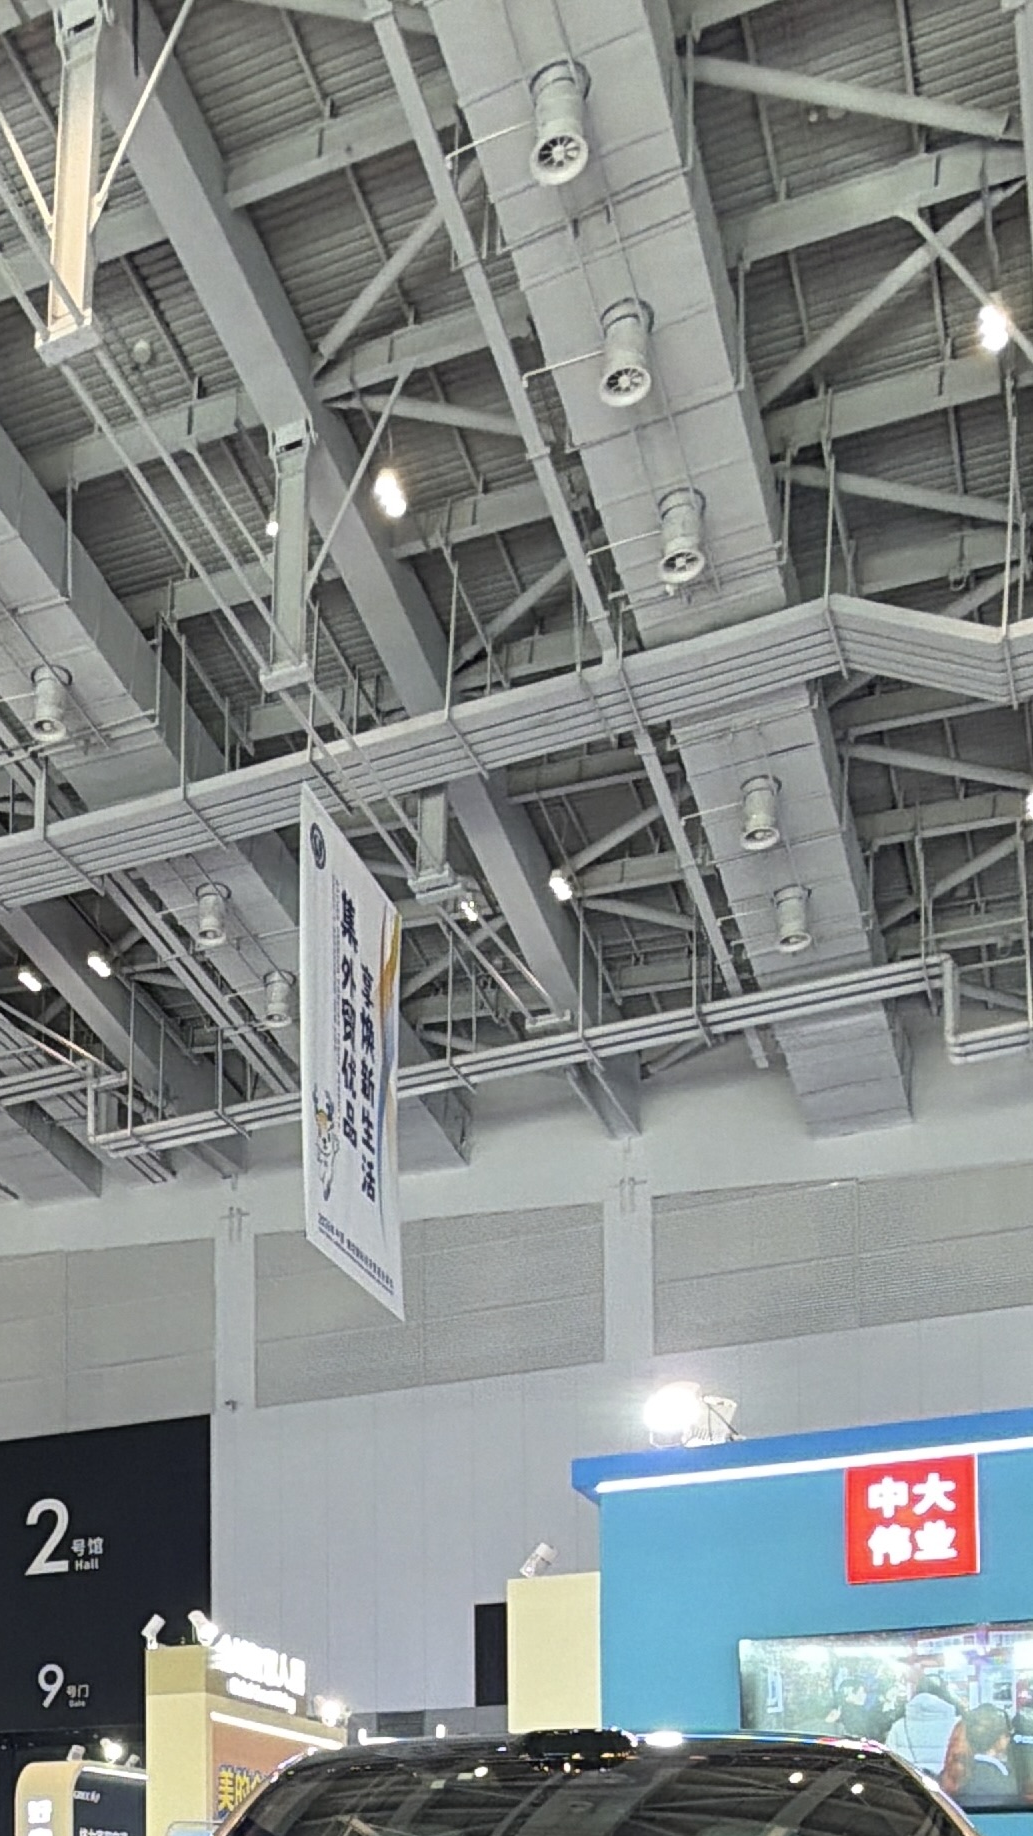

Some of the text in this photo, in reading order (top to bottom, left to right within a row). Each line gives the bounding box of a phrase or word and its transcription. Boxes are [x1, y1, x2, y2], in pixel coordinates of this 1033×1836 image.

[867, 1472, 957, 1519] 中大
[24, 1498, 69, 1576] 2
[71, 1537, 105, 1557] 号馆
[867, 1520, 958, 1567] 伟业
[74, 1558, 100, 1571] Hall
[37, 1663, 65, 1708] 9
[66, 1684, 90, 1698] 号门
